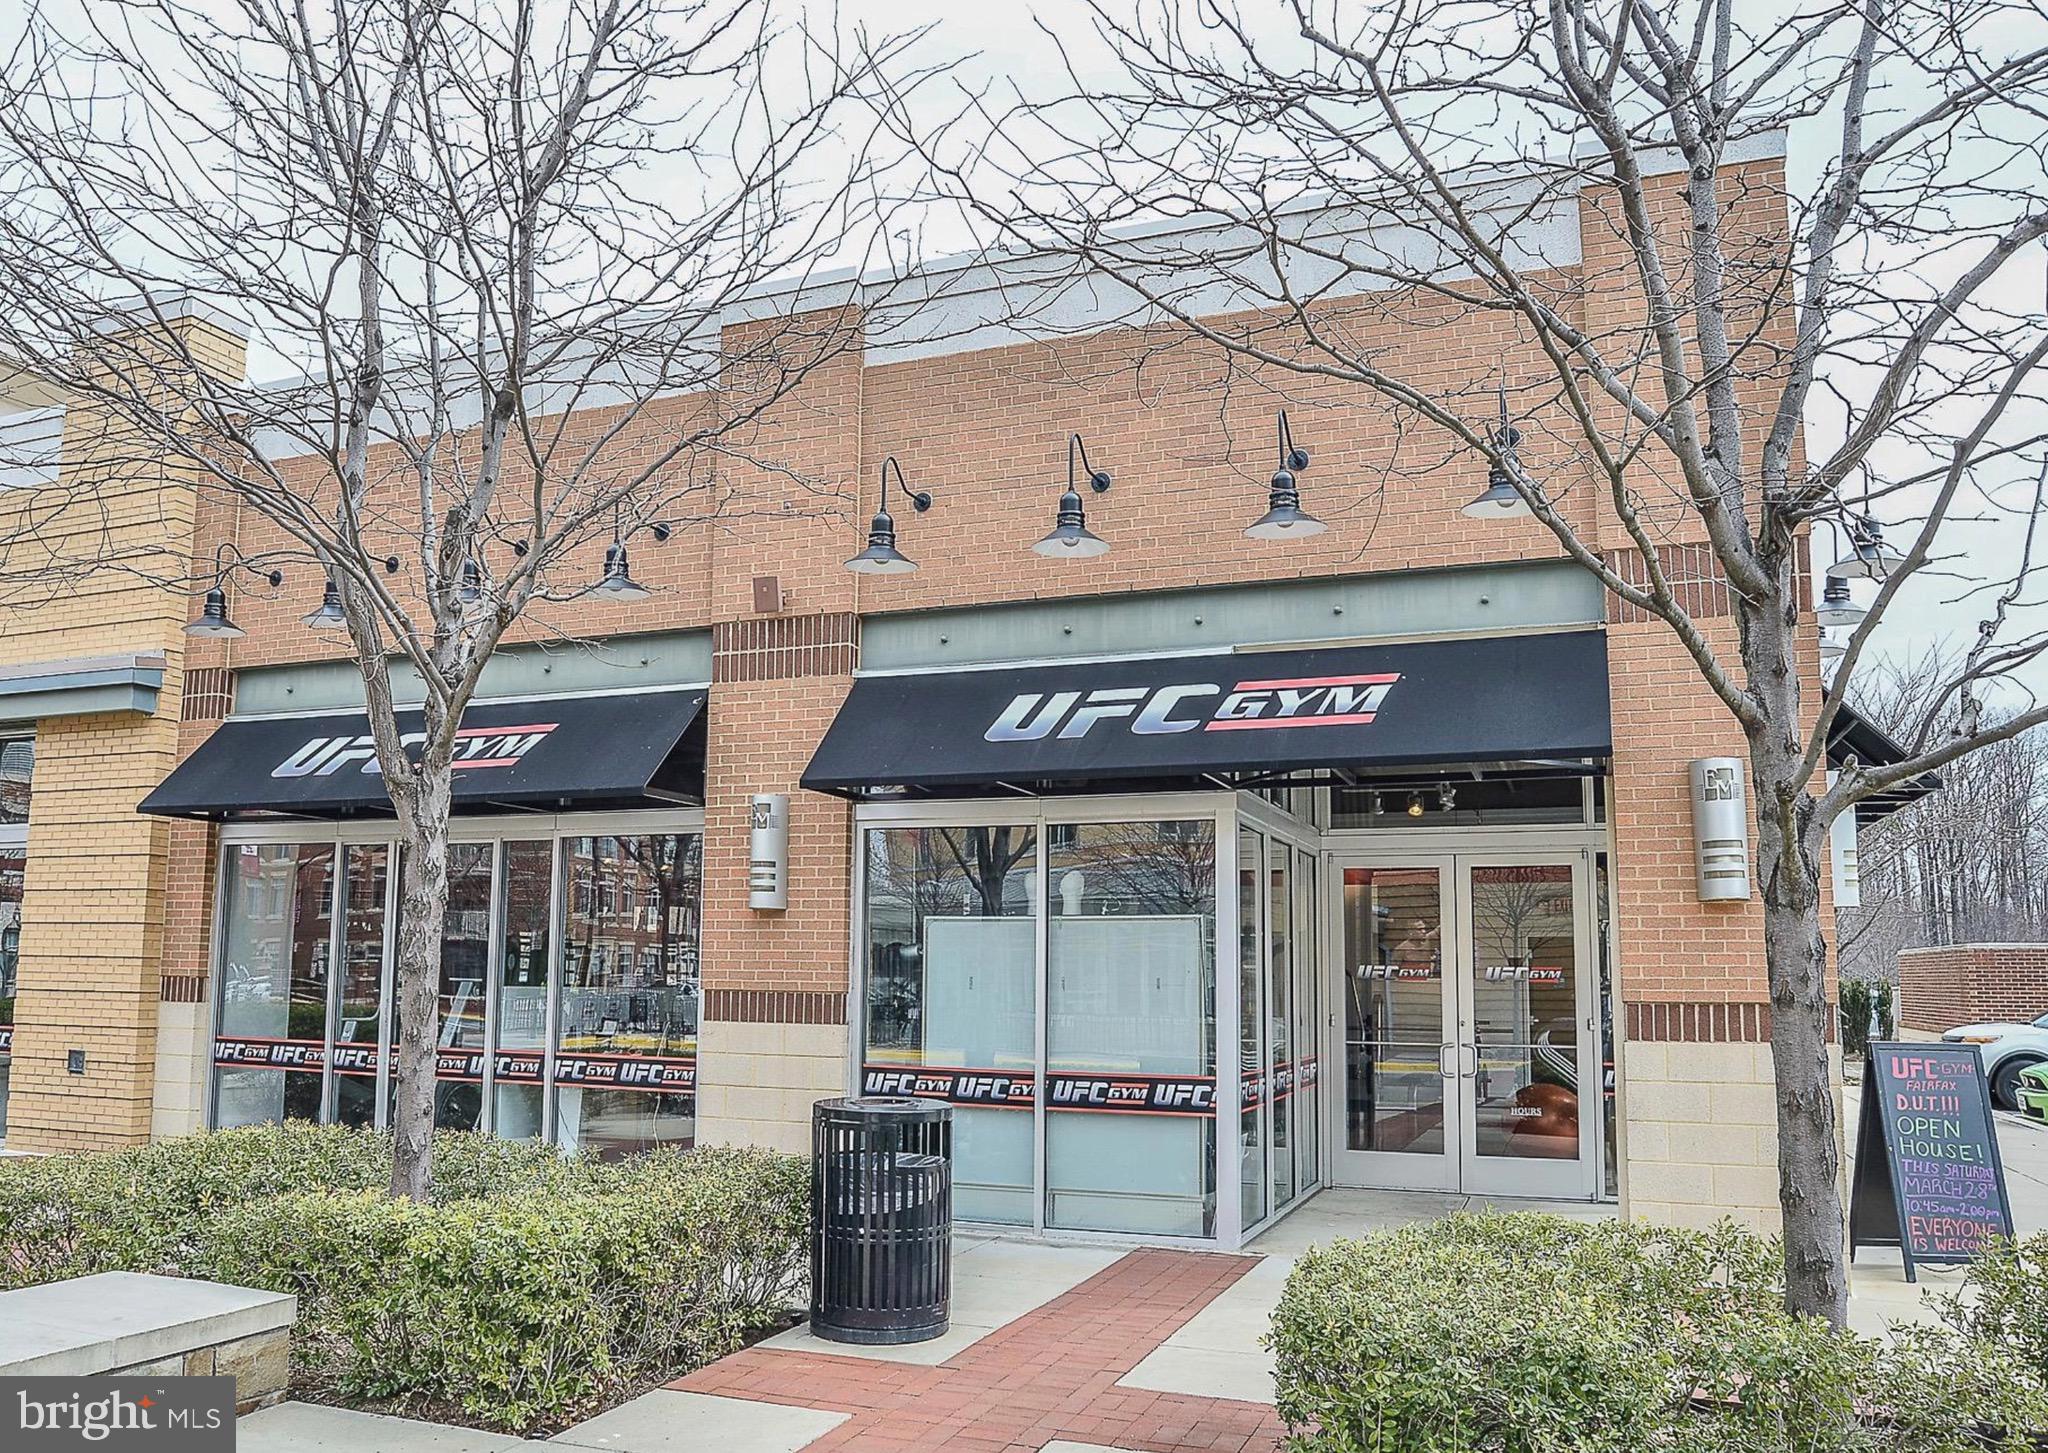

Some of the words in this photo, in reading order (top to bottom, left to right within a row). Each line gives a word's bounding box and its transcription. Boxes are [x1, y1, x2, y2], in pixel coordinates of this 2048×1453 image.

[984, 683, 1220, 742] UFC
[1213, 684, 1393, 719] GYM
[1357, 965, 1399, 980] UFC
[1398, 968, 1431, 978] GYM
[1485, 966, 1529, 982] UFC
[1529, 970, 1562, 979] GYM
[244, 1047, 270, 1058] GYM
[271, 1045, 306, 1064] UFC
[334, 1048, 368, 1068] UFC
[438, 1060, 466, 1070] GYM
[469, 1056, 512, 1076] UC
[510, 1062, 540, 1073] GYM
[586, 1065, 617, 1077] GYM
[620, 1063, 664, 1084] UFC
[663, 1069, 695, 1081] GYM
[1892, 1056, 1938, 1079] UFC
[865, 1072, 916, 1095] UFC
[914, 1079, 951, 1092] GYM
[956, 1076, 1010, 1099] UFC
[1009, 1083, 1036, 1096] GY
[1053, 1080, 1108, 1103] UFC
[1108, 1087, 1149, 1100] GYM
[1154, 1084, 1211, 1107] UFC
[1906, 1080, 1957, 1091] FAIRFAX
[1510, 1107, 1542, 1116] HOURS
[1897, 1116, 1960, 1138] OPEN
[1899, 1137, 1984, 1163] HOUSE!
[1902, 1159, 1940, 1173] THIS
[1943, 1163, 1995, 1179] SATURDAY
[1904, 1177, 1962, 1195] MARCH
[1910, 1216, 1998, 1238] EVERYONE
[1914, 1238, 1928, 1251] IS
[1935, 1238, 1993, 1252] WELCO
